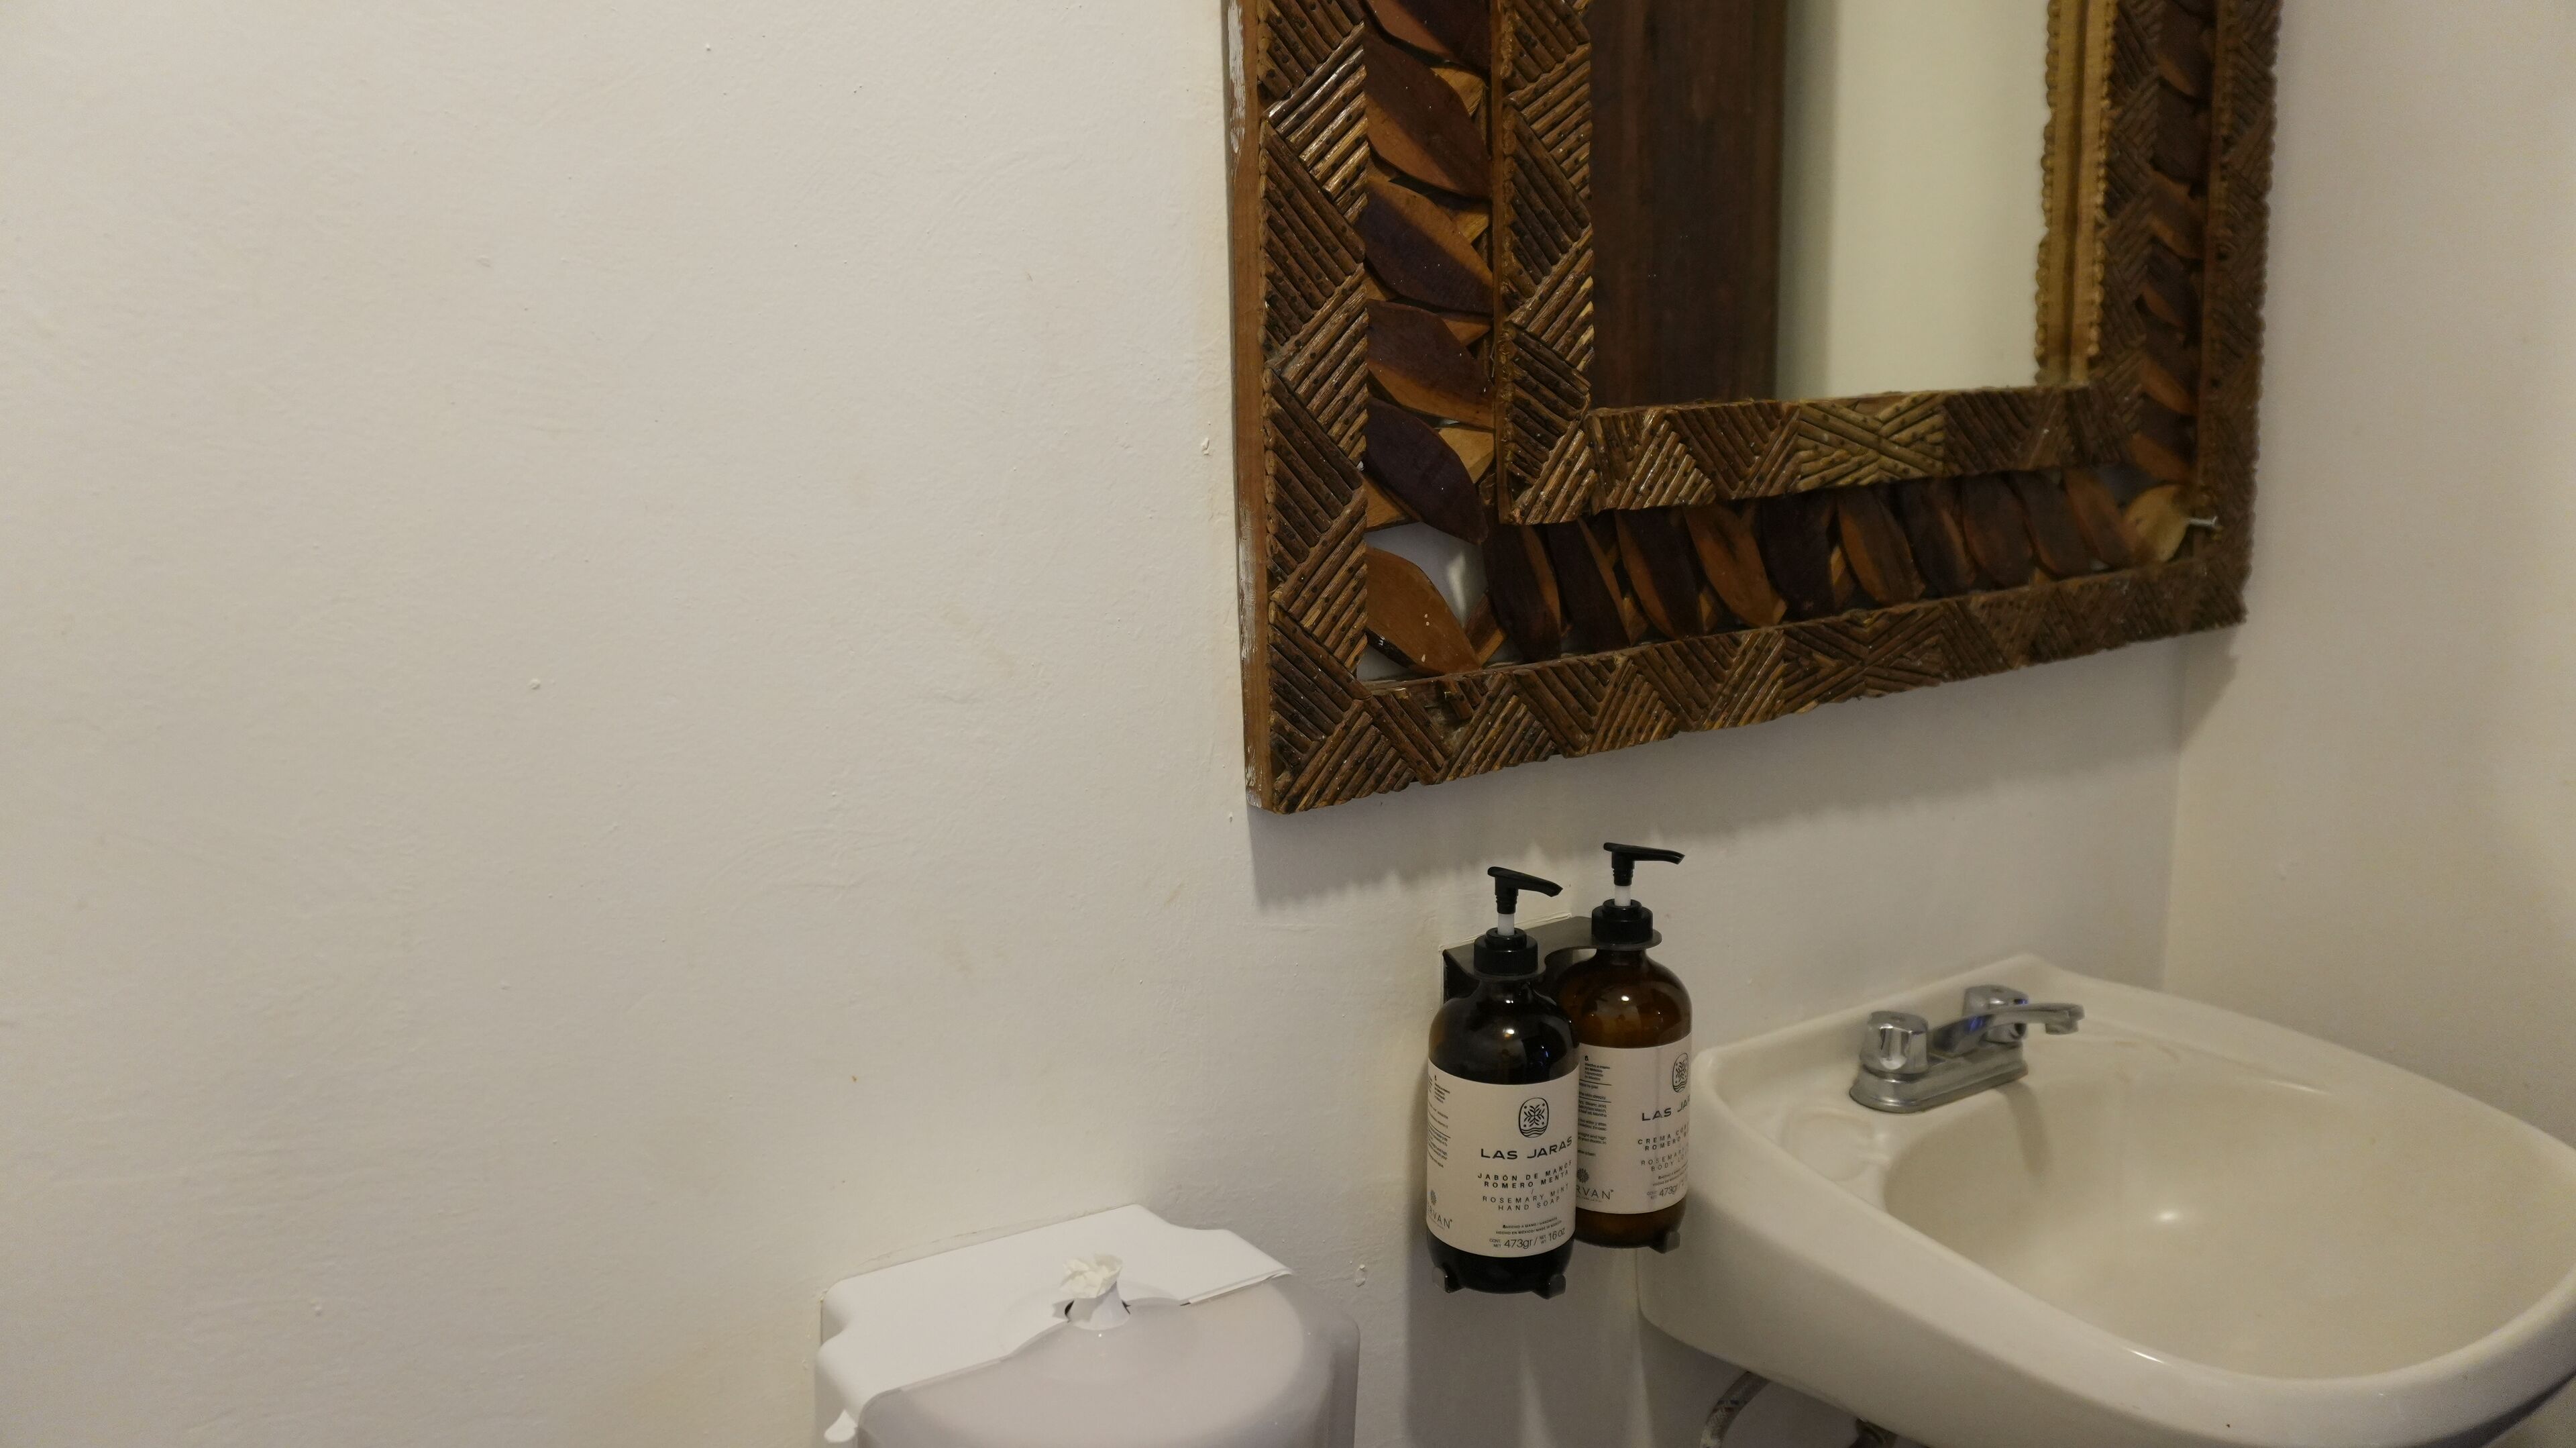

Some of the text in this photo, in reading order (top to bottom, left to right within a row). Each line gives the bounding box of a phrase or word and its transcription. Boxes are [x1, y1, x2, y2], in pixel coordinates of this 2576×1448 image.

[1642, 1107, 1672, 1121] LAS
[1638, 1133, 1671, 1145] CREMA
[1645, 1136, 1680, 1151] ROMERO
[1481, 1148, 1518, 1159] LAS
[1527, 1136, 1572, 1158] JARAS
[1477, 1159, 1572, 1181] JABÓN DE MANOS
[1651, 1160, 1673, 1172] BODY
[1541, 1170, 1568, 1186] MENTA
[1483, 1183, 1568, 1204] ROSEMARY MINT
[1576, 1184, 1611, 1200] RVAN
[1536, 1196, 1560, 1208] SOAP
[1504, 1238, 1534, 1249] 473gr
